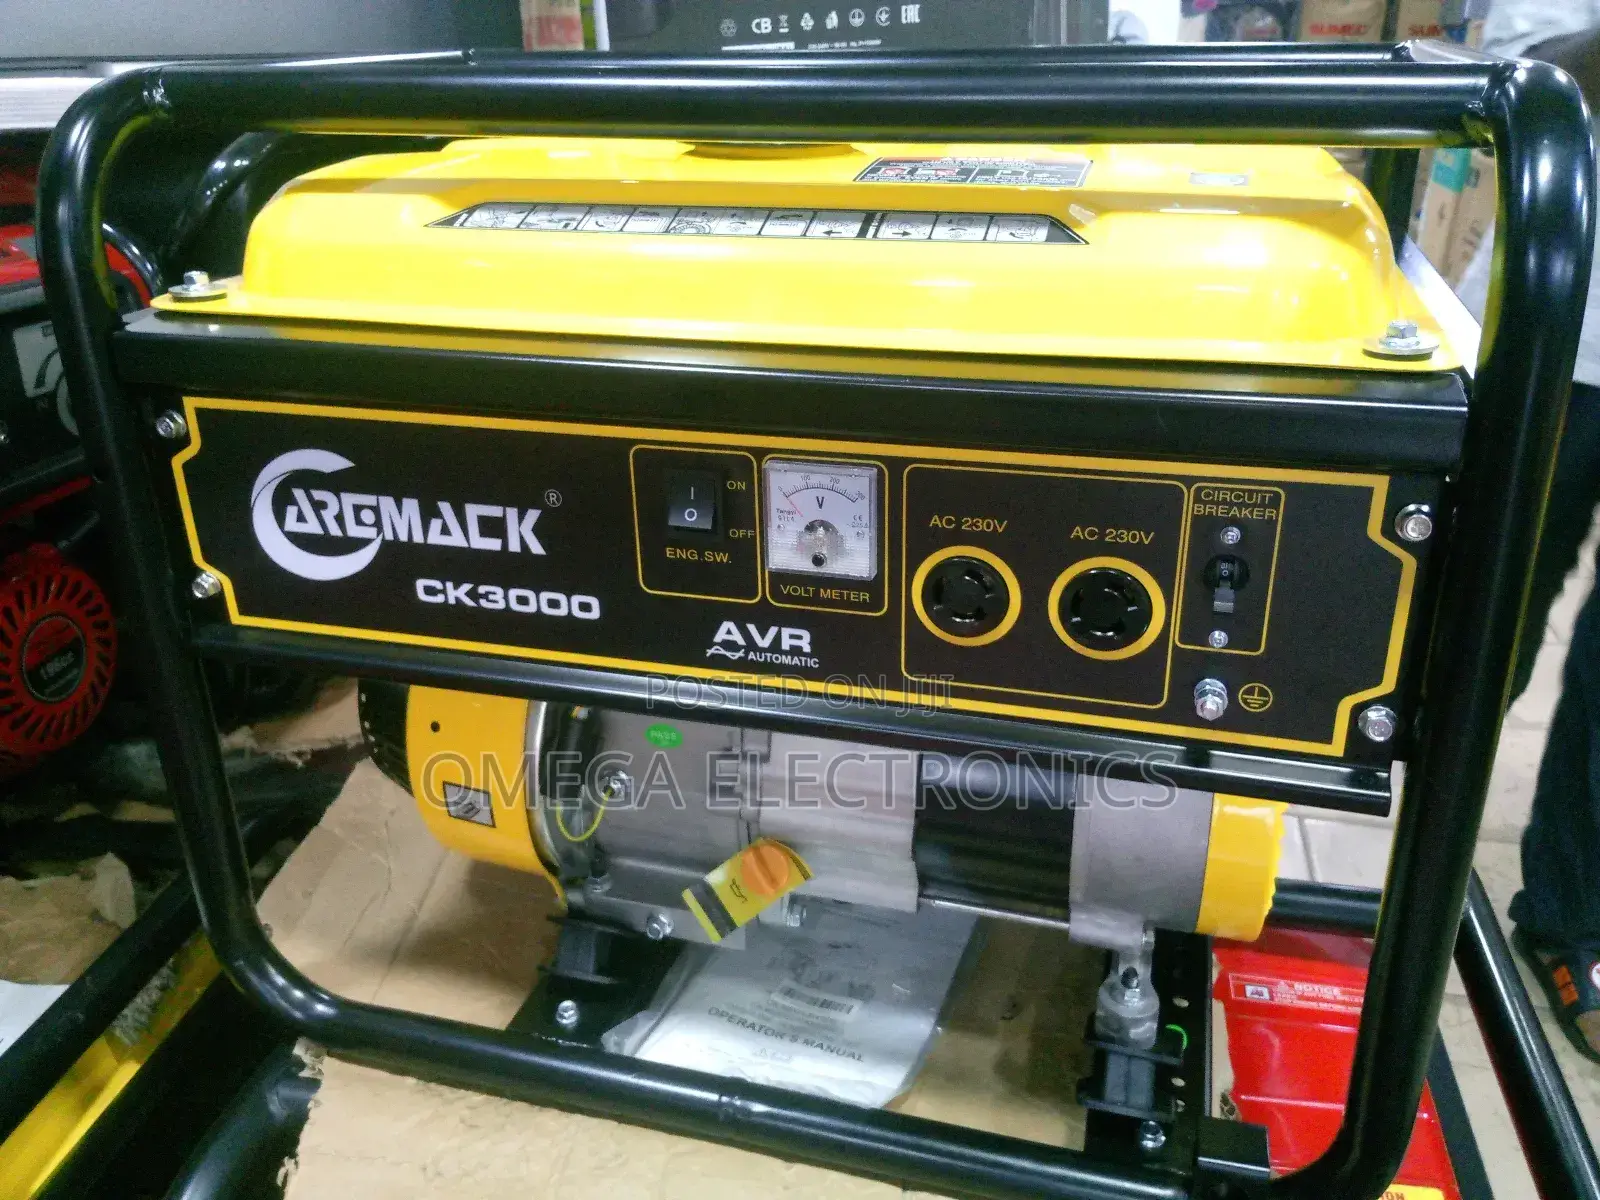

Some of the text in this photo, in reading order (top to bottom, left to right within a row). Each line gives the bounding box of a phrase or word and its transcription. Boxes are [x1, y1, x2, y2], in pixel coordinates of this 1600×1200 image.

[726, 480, 746, 491] ON
[815, 496, 825, 510] V
[1200, 488, 1274, 505] CIRCUIT
[1193, 503, 1277, 521] BREAKER
[729, 528, 755, 539] OFF
[929, 515, 1008, 534] AC 230V
[1070, 526, 1155, 546] AC 230V
[415, 578, 601, 620] CK3000
[780, 584, 870, 603] VOLT METER
[712, 620, 812, 653] AVR
[747, 651, 820, 668] AUTOMATIC
[803, 1037, 864, 1063] MANUAL
